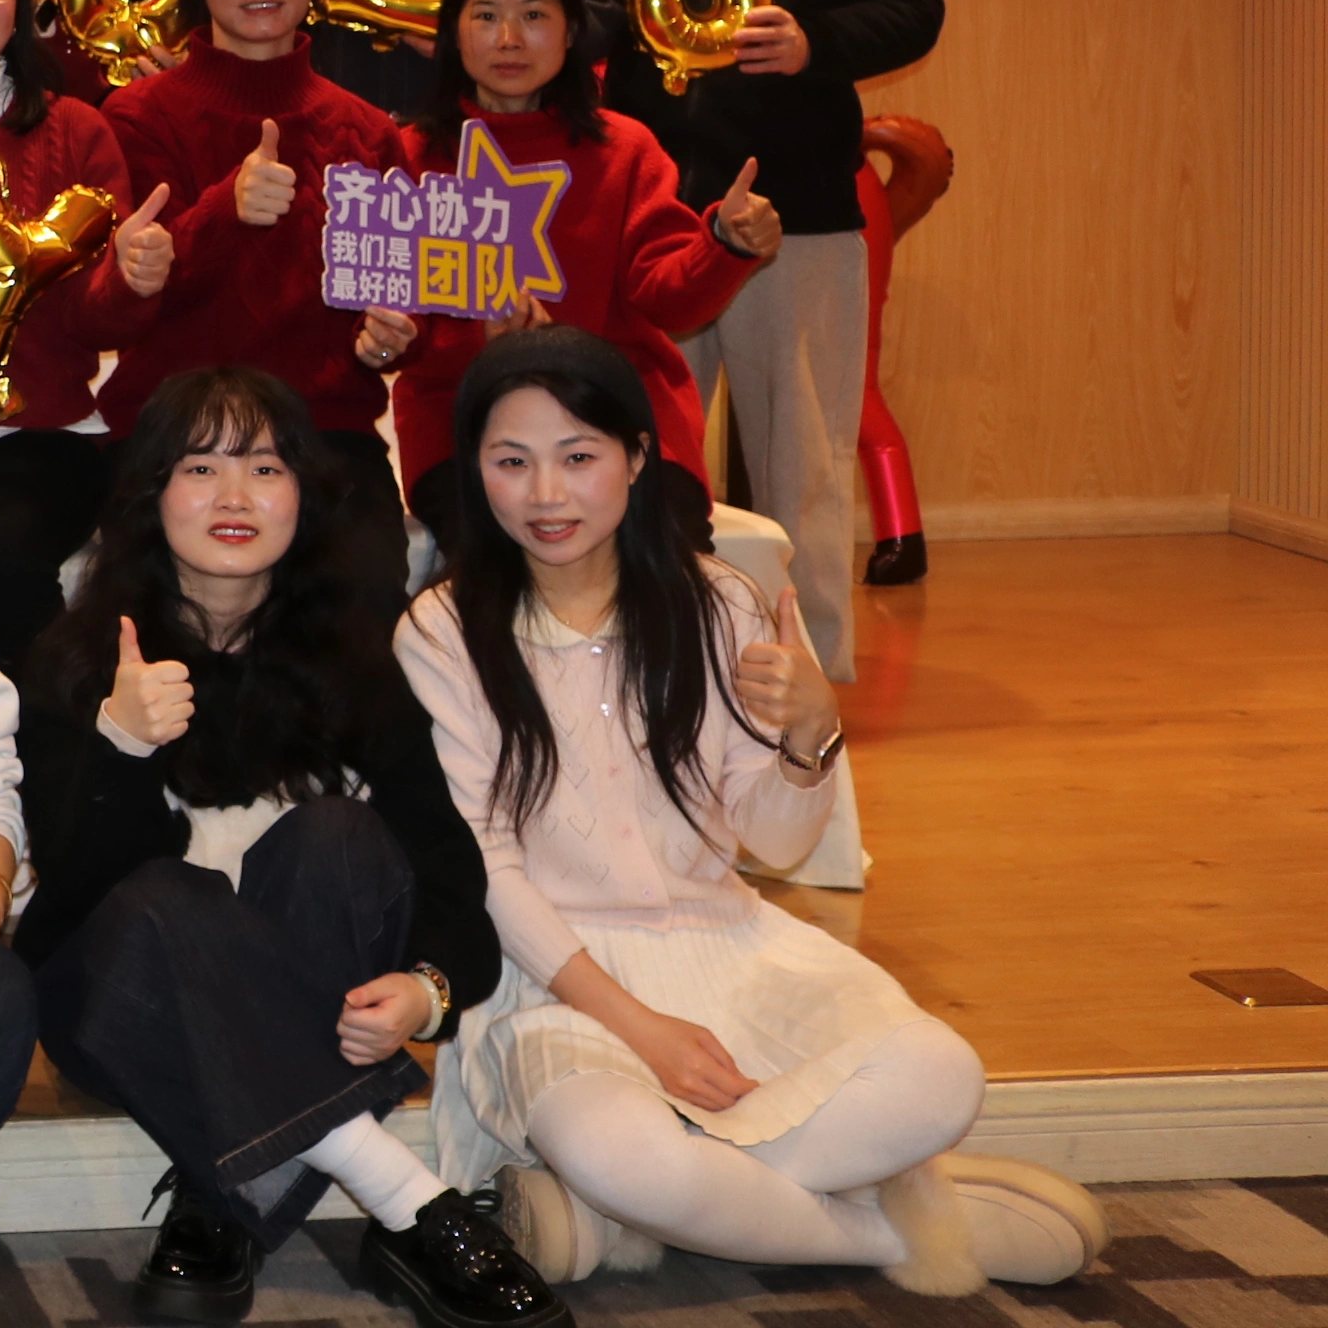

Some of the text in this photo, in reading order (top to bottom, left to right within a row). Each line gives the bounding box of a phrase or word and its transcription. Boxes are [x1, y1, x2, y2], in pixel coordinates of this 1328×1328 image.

[332, 170, 511, 243] 齐心协力
[331, 230, 412, 271] 我们是
[418, 235, 520, 312] 团队
[331, 267, 412, 308] 最好的
